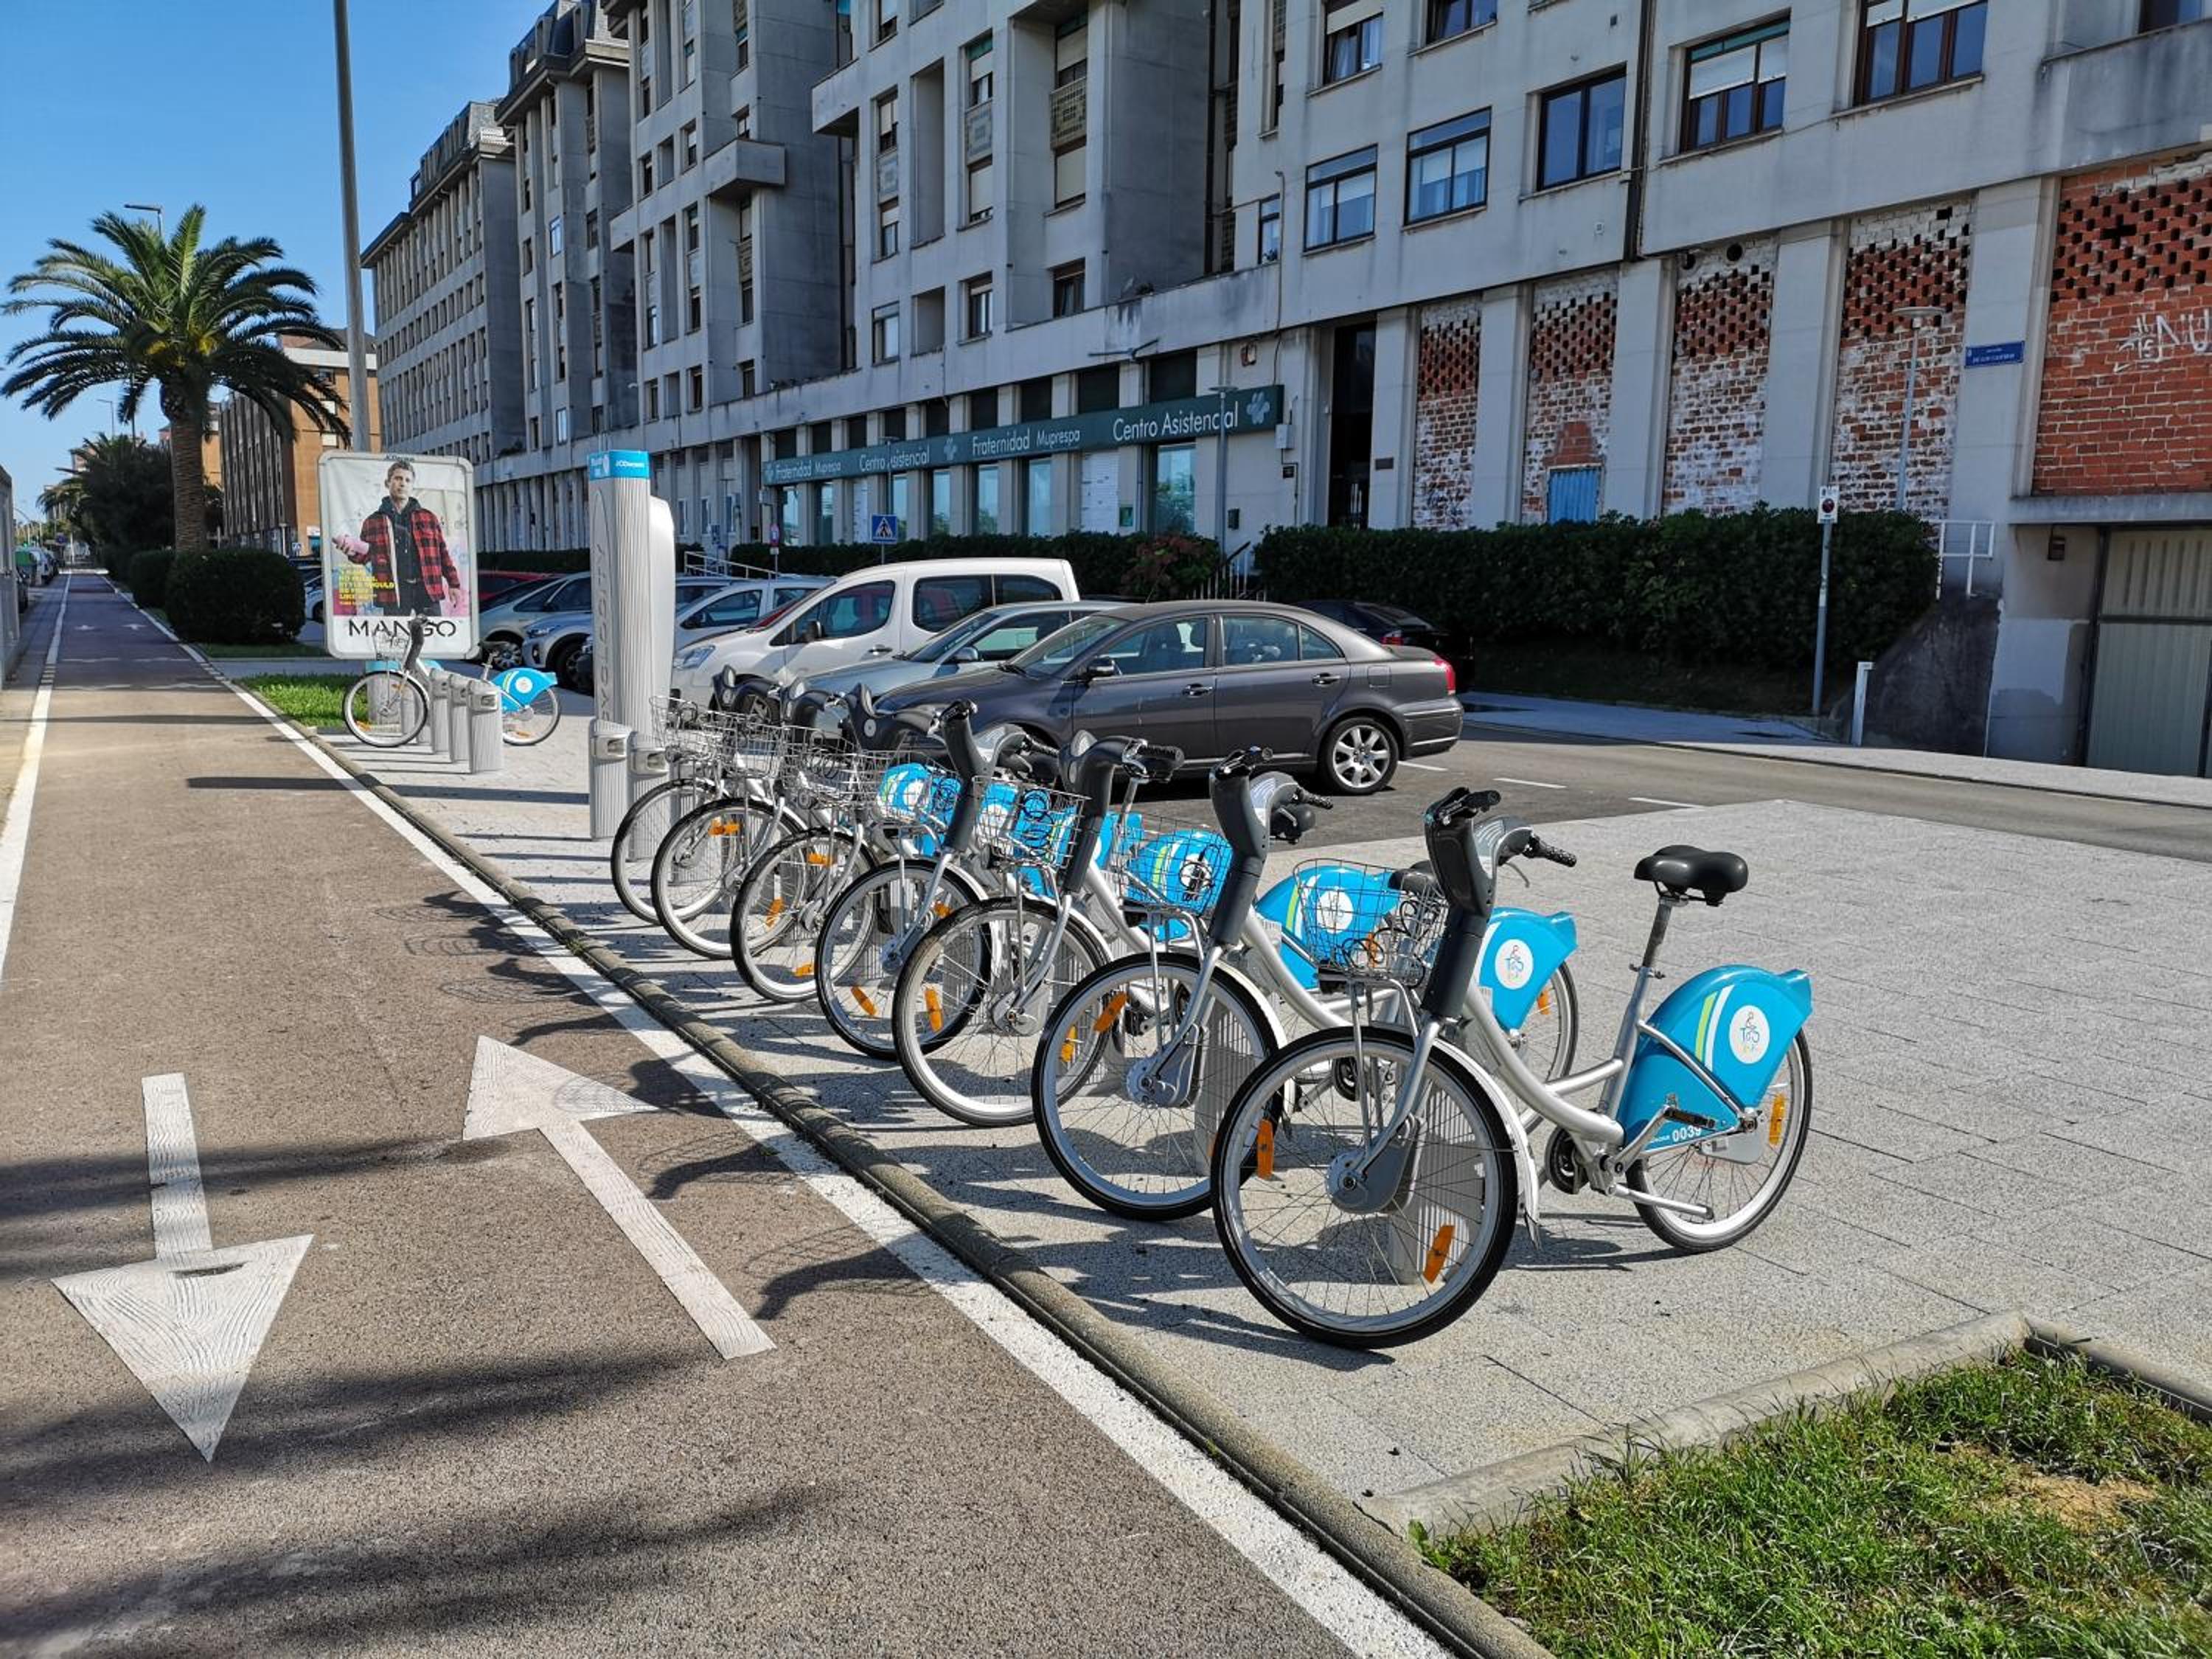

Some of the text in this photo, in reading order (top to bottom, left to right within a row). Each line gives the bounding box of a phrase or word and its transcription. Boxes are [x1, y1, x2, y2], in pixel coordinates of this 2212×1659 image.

[1113, 400, 1239, 441] Centro Asistencal
[973, 428, 1080, 456] Fraternidad Muprespa
[776, 459, 812, 479] Fraternidad
[859, 454, 885, 472] Centro
[349, 619, 457, 637] MANGO
[1672, 1124, 1703, 1142] 0039
